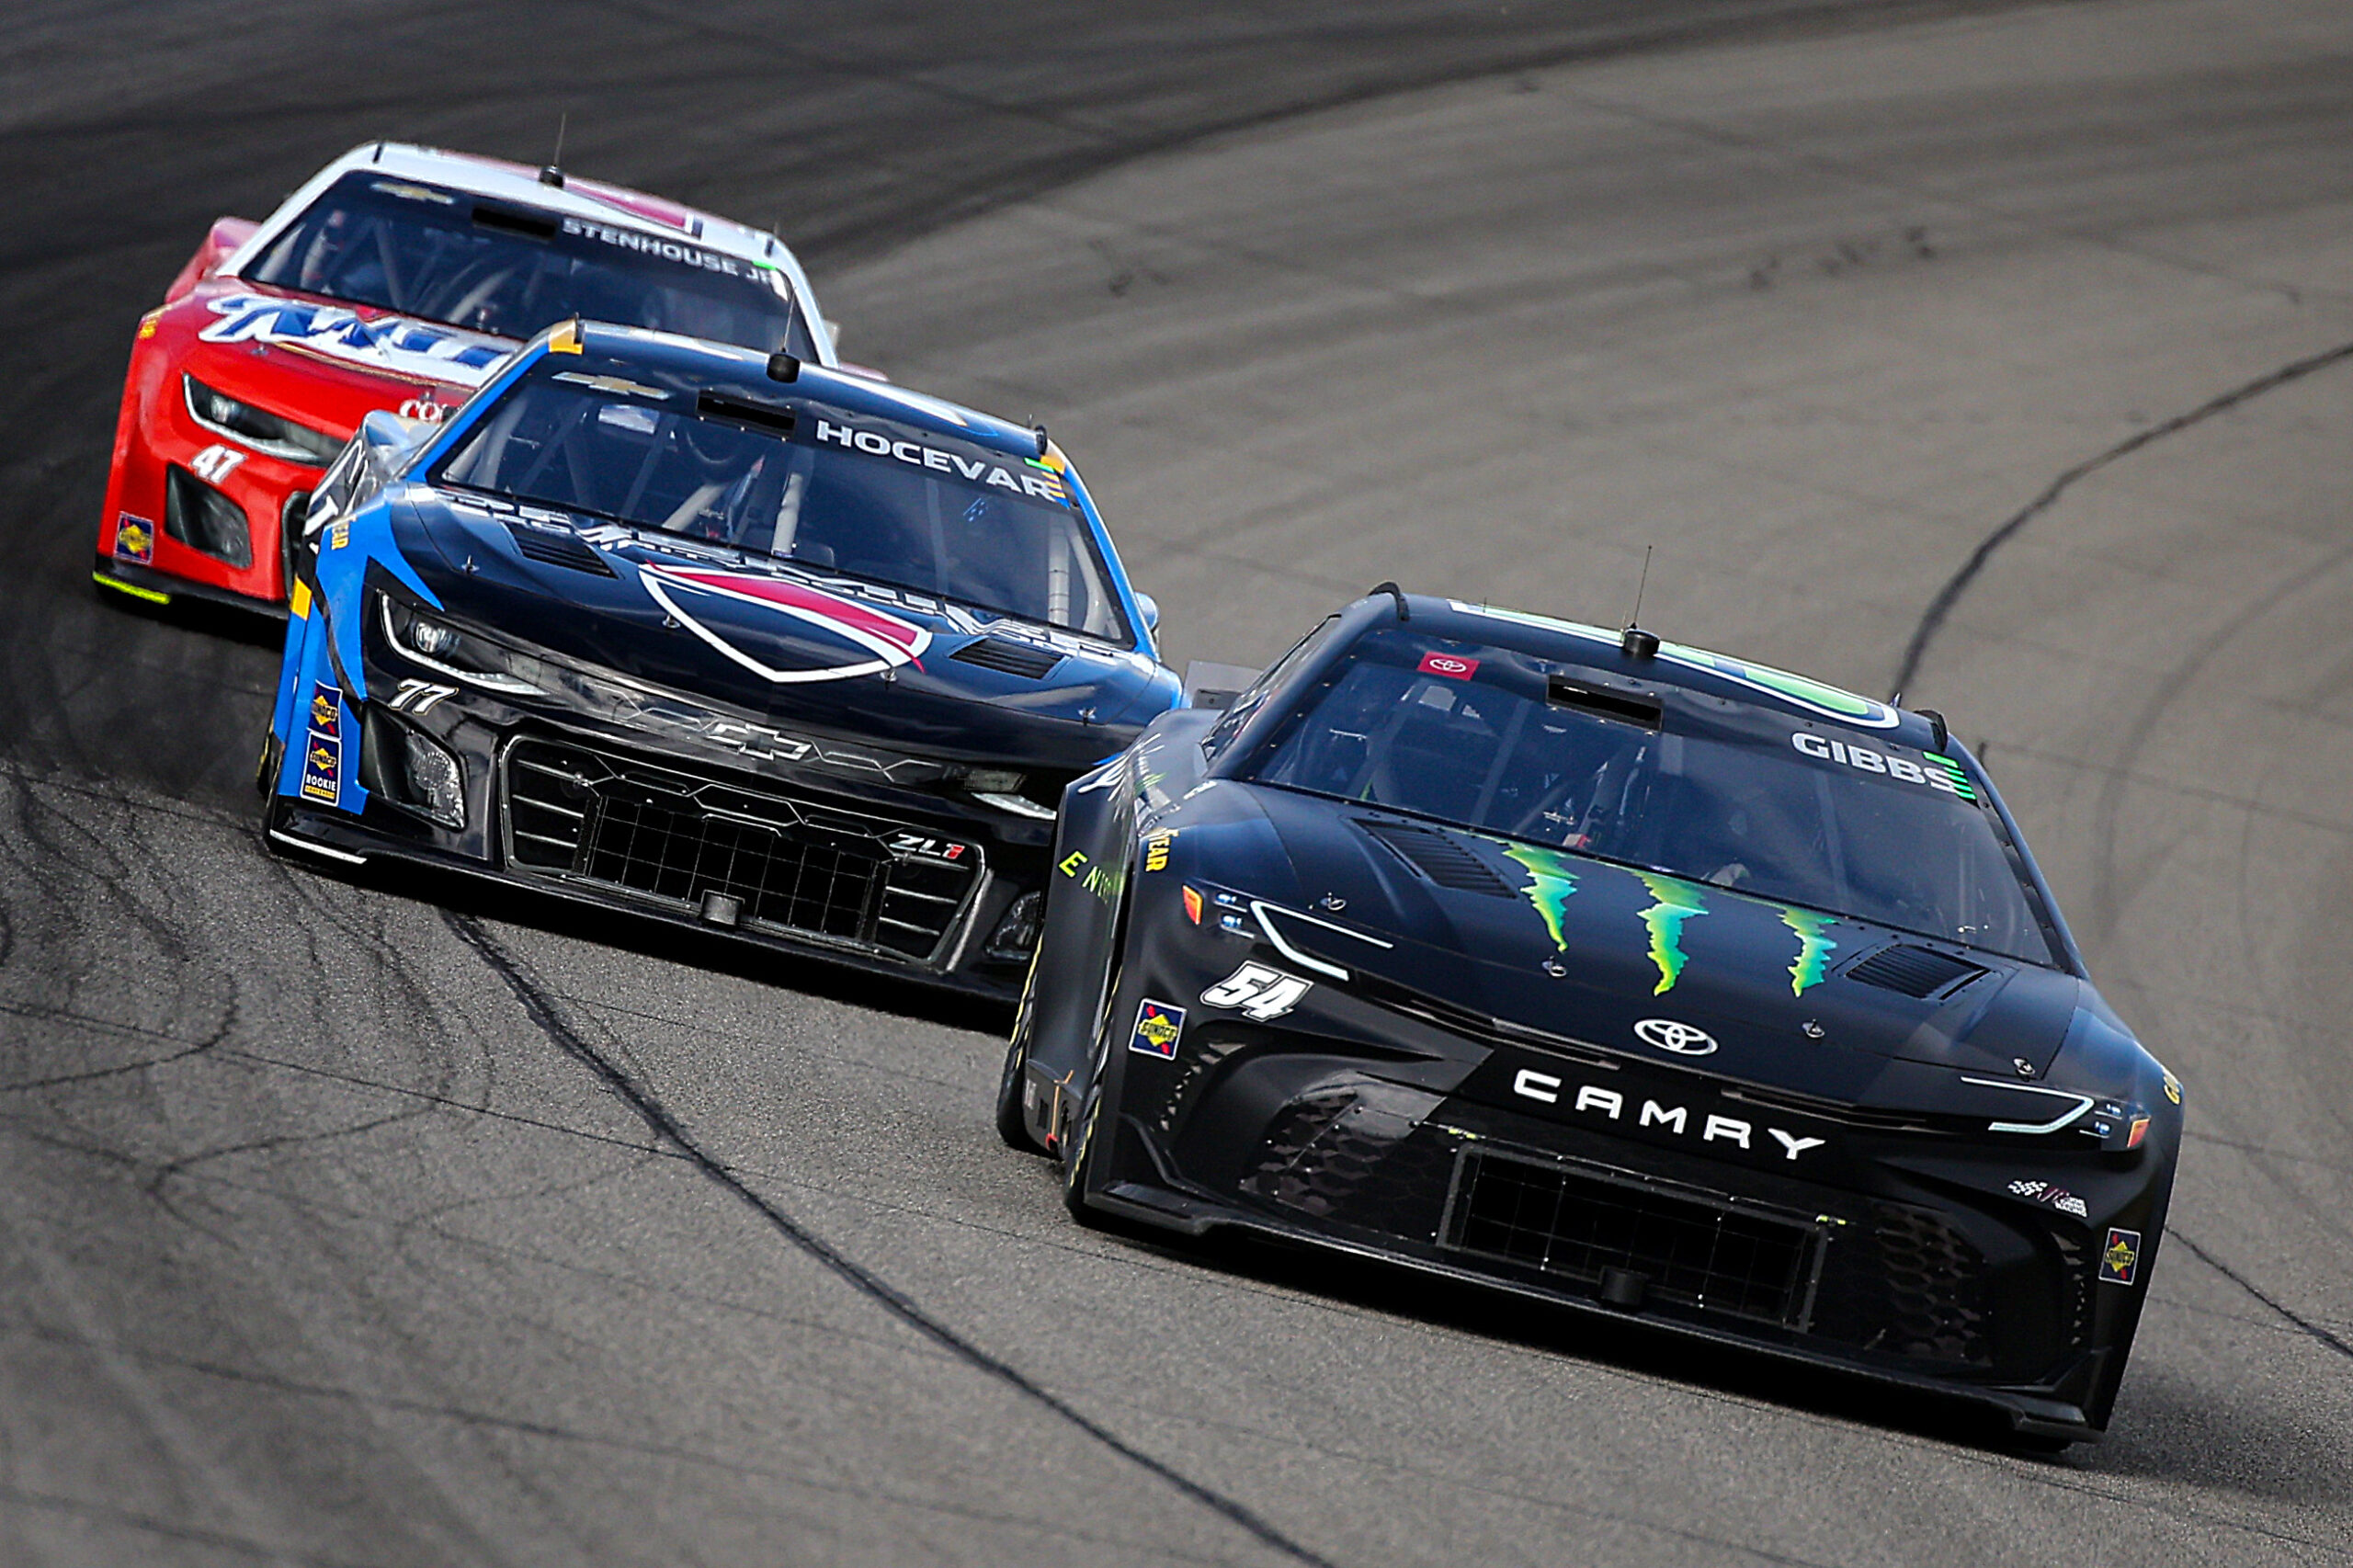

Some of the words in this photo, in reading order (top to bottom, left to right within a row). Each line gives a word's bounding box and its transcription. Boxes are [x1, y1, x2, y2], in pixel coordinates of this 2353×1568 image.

[562, 217, 738, 277] STENHOUSE
[191, 444, 248, 485] 47
[816, 419, 1057, 502] HOCEVAR
[389, 678, 459, 716] 77
[306, 774, 336, 791] ROOKIE
[1791, 733, 1958, 795] GIBBS
[889, 833, 965, 859] ZL1
[1199, 960, 1314, 1022] 54
[1138, 1019, 1178, 1041] SUNOCO
[1514, 1069, 1825, 1160] CAMRY
